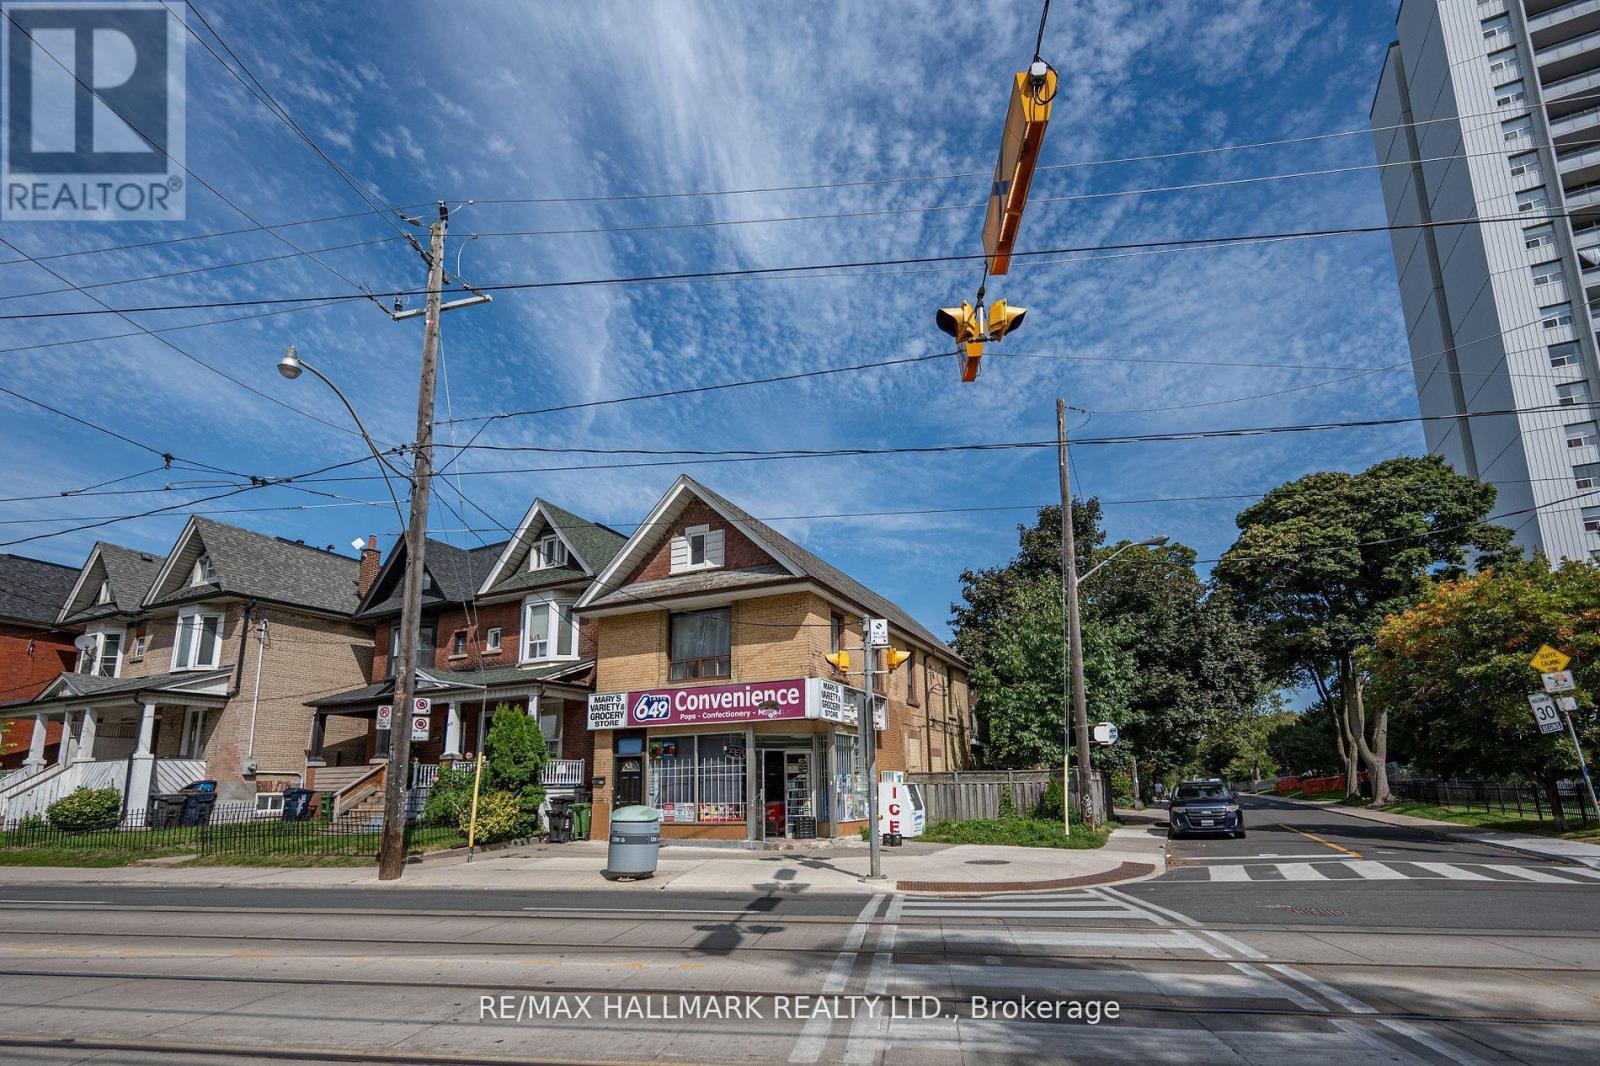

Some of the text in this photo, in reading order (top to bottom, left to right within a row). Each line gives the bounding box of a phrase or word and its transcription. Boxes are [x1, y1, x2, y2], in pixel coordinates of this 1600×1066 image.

[675, 685, 800, 711] Convenience
[590, 703, 621, 712] VARIETY
[1537, 705, 1555, 721] 30
[590, 711, 625, 721] GROCERY
[680, 713, 697, 721] Pops
[702, 709, 750, 719] Confectionery
[595, 719, 620, 728] STORE
[889, 787, 900, 833] ICE
